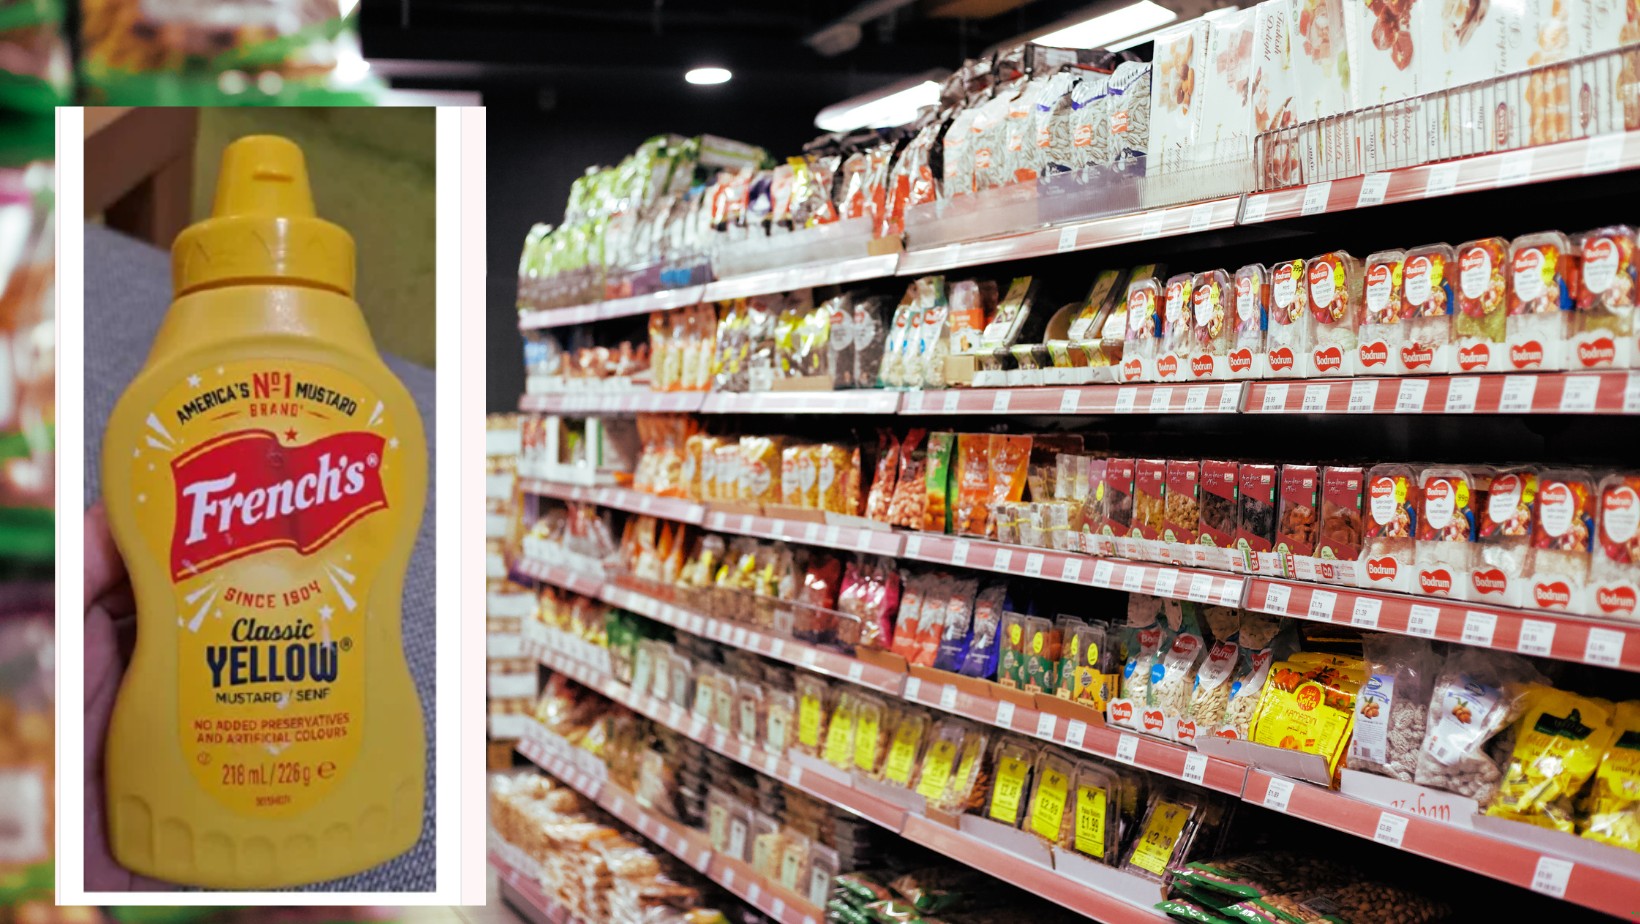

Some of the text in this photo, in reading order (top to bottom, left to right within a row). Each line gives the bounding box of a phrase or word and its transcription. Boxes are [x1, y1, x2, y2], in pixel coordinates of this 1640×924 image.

[1361, 350, 1386, 360] Bodrum
[1402, 353, 1432, 363] Bodrum
[1459, 353, 1489, 363] Bodrum
[1512, 350, 1541, 361] Bodrum
[1580, 347, 1614, 359] Bodrum
[1230, 355, 1251, 365] Bodrum
[1269, 354, 1293, 365] Bodrum
[1316, 354, 1341, 365] Bodrum
[1158, 362, 1177, 371] Bodrum
[1192, 362, 1213, 372] Bodrum
[176, 382, 250, 424] AMERICA'S
[295, 381, 357, 417] MUSTARD
[1371, 486, 1392, 494] Bodrum
[1427, 487, 1448, 497] Bodrum
[1457, 494, 1468, 502] 99p
[1542, 491, 1567, 502] Bodrum
[1368, 565, 1396, 575] Bodrum
[1421, 576, 1450, 589] Bodrum
[1475, 577, 1505, 589] Bodrum
[224, 579, 322, 608] SINCE 1904
[1536, 589, 1569, 602] Bodrum
[1600, 594, 1635, 607] Bodrum
[231, 617, 314, 643] Classic
[215, 691, 282, 705] MUSTARD
[296, 687, 331, 703] SENF
[1112, 707, 1131, 717] Bodrum
[194, 712, 350, 732] NO ADDED PRESERVATIVES
[1144, 715, 1163, 728] Bodrum
[197, 726, 347, 744] AND ARTIFICIAL COLOURS
[222, 763, 245, 786] 218
[278, 761, 300, 784] 226
